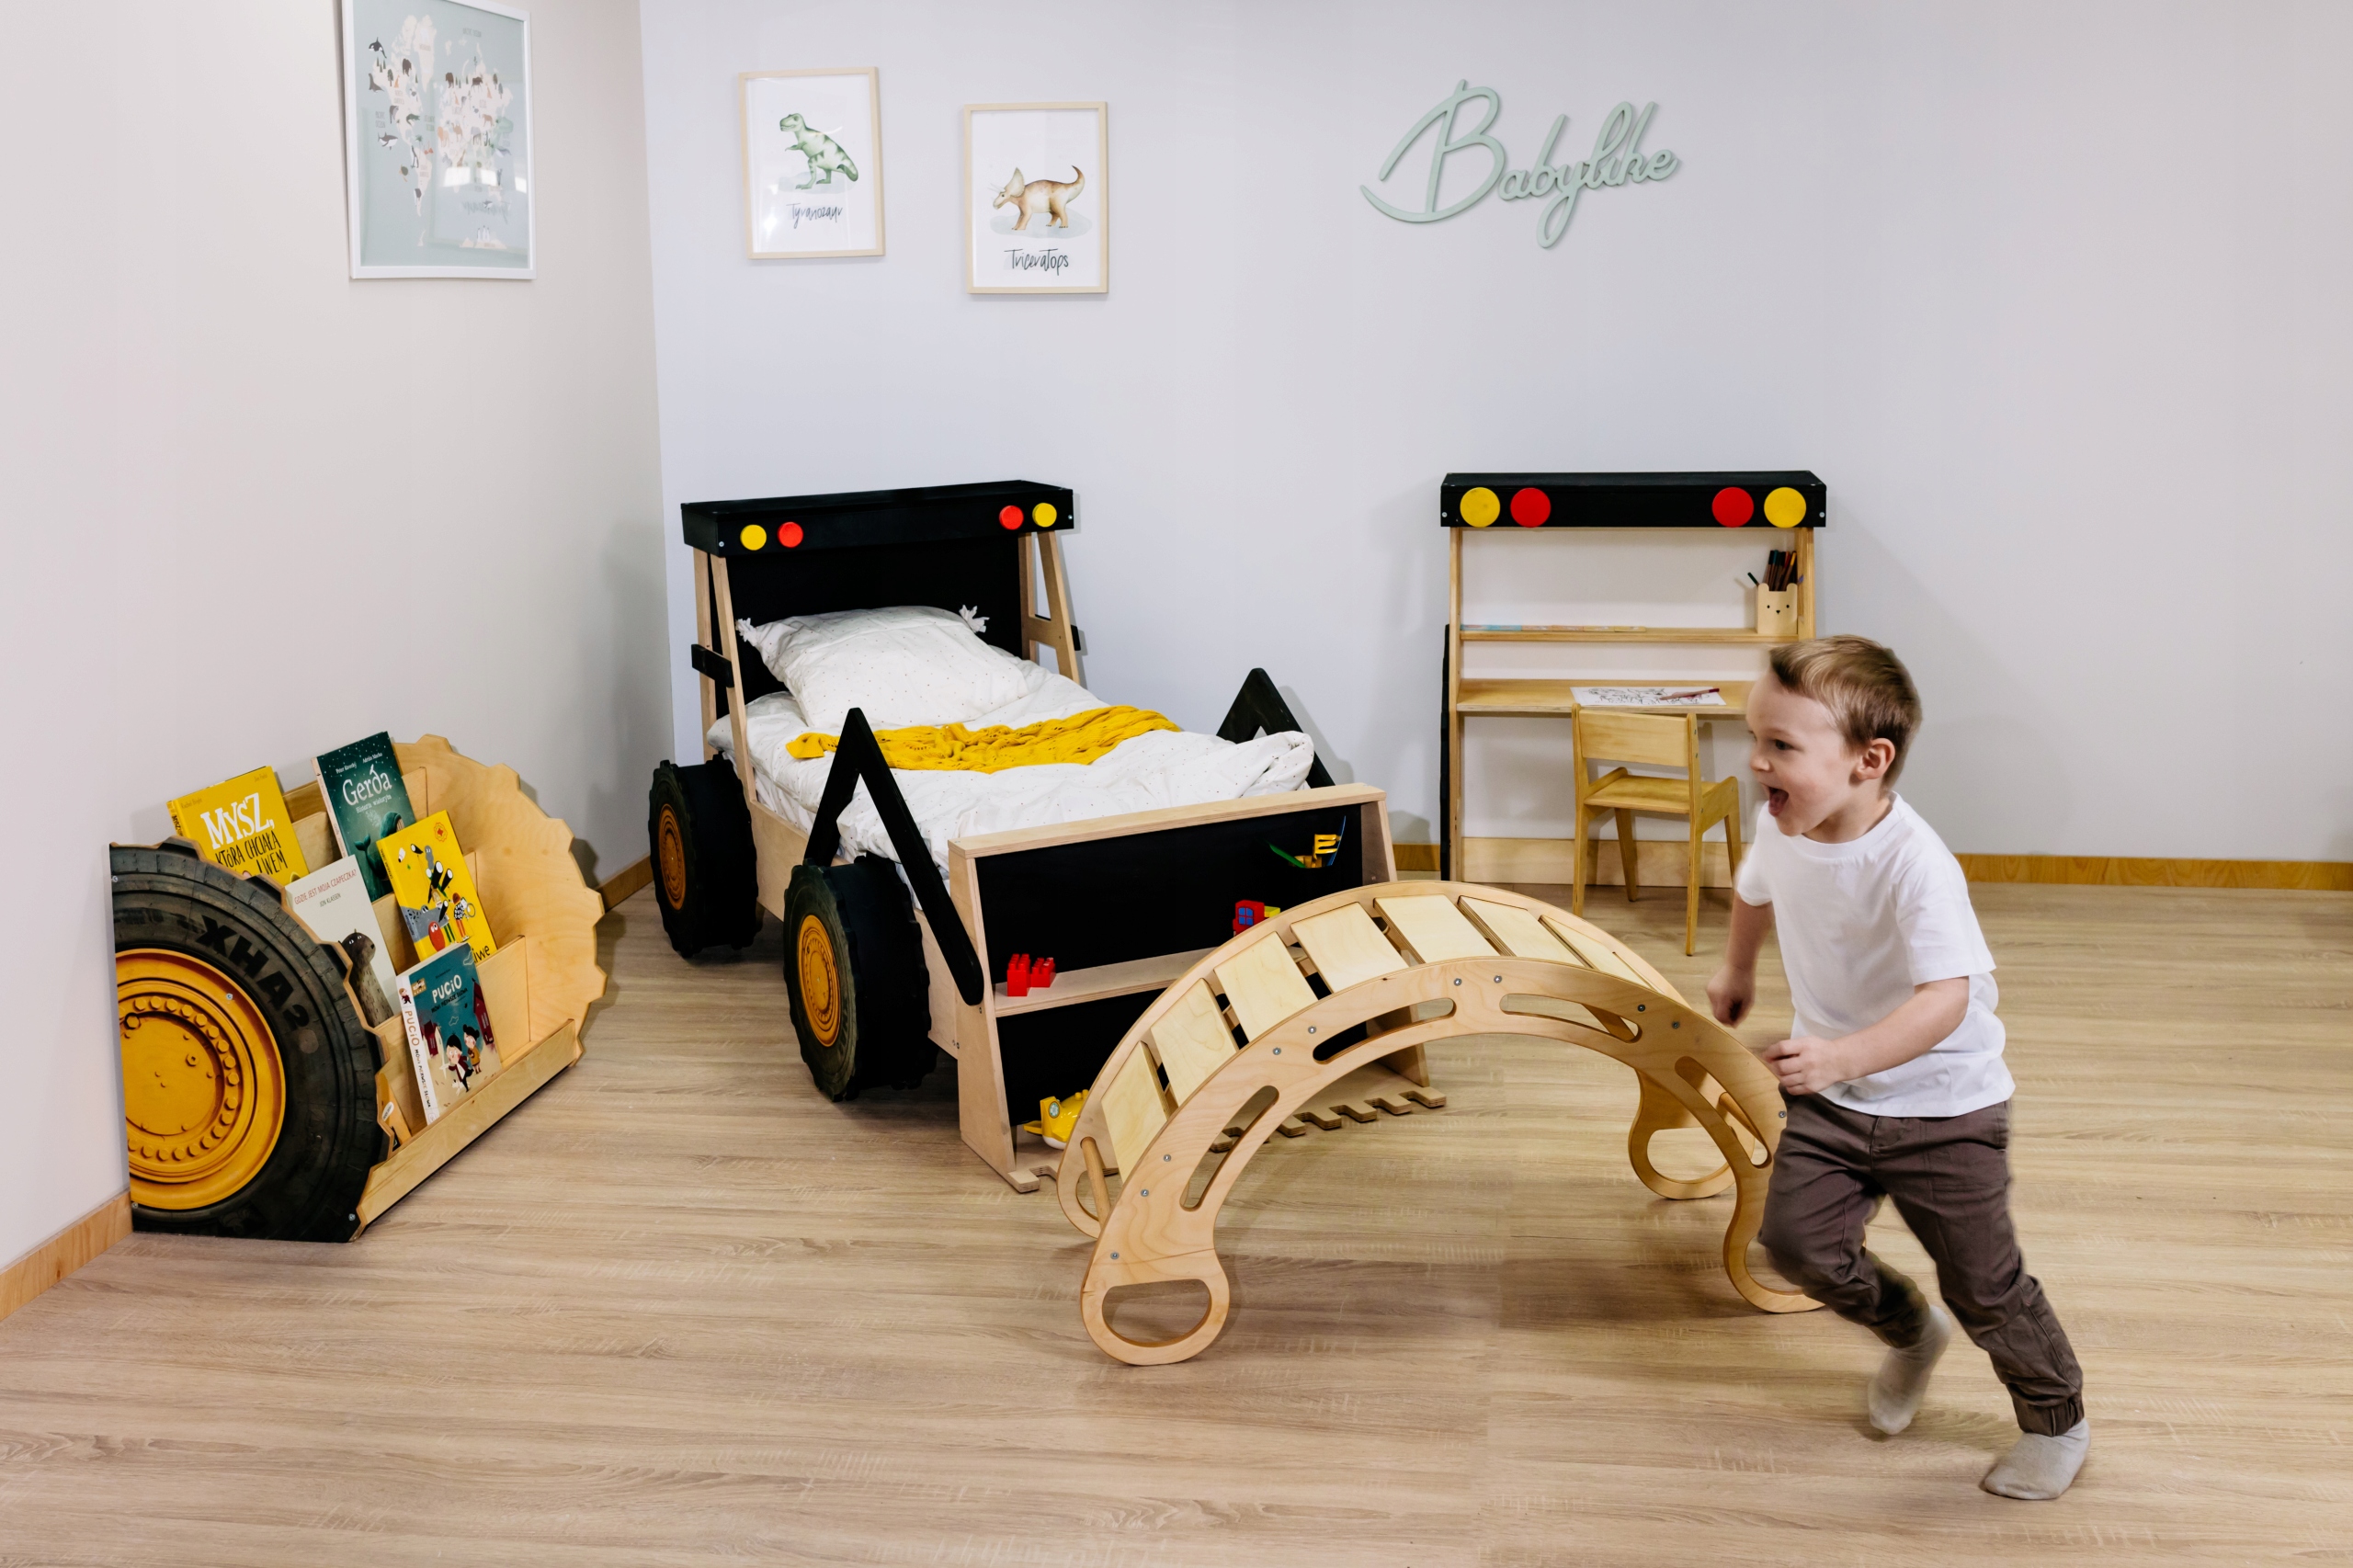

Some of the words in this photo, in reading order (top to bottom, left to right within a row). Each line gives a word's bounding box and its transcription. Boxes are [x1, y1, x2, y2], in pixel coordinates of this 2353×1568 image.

[1360, 79, 1678, 248] Babylike
[786, 202, 843, 229] Tyranozaur
[200, 792, 275, 850] MYSZ,
[244, 830, 281, 859] CHCIAŁA
[294, 892, 308, 904] GDZIE
[308, 887, 318, 899] JEST
[318, 882, 331, 893] MOJA
